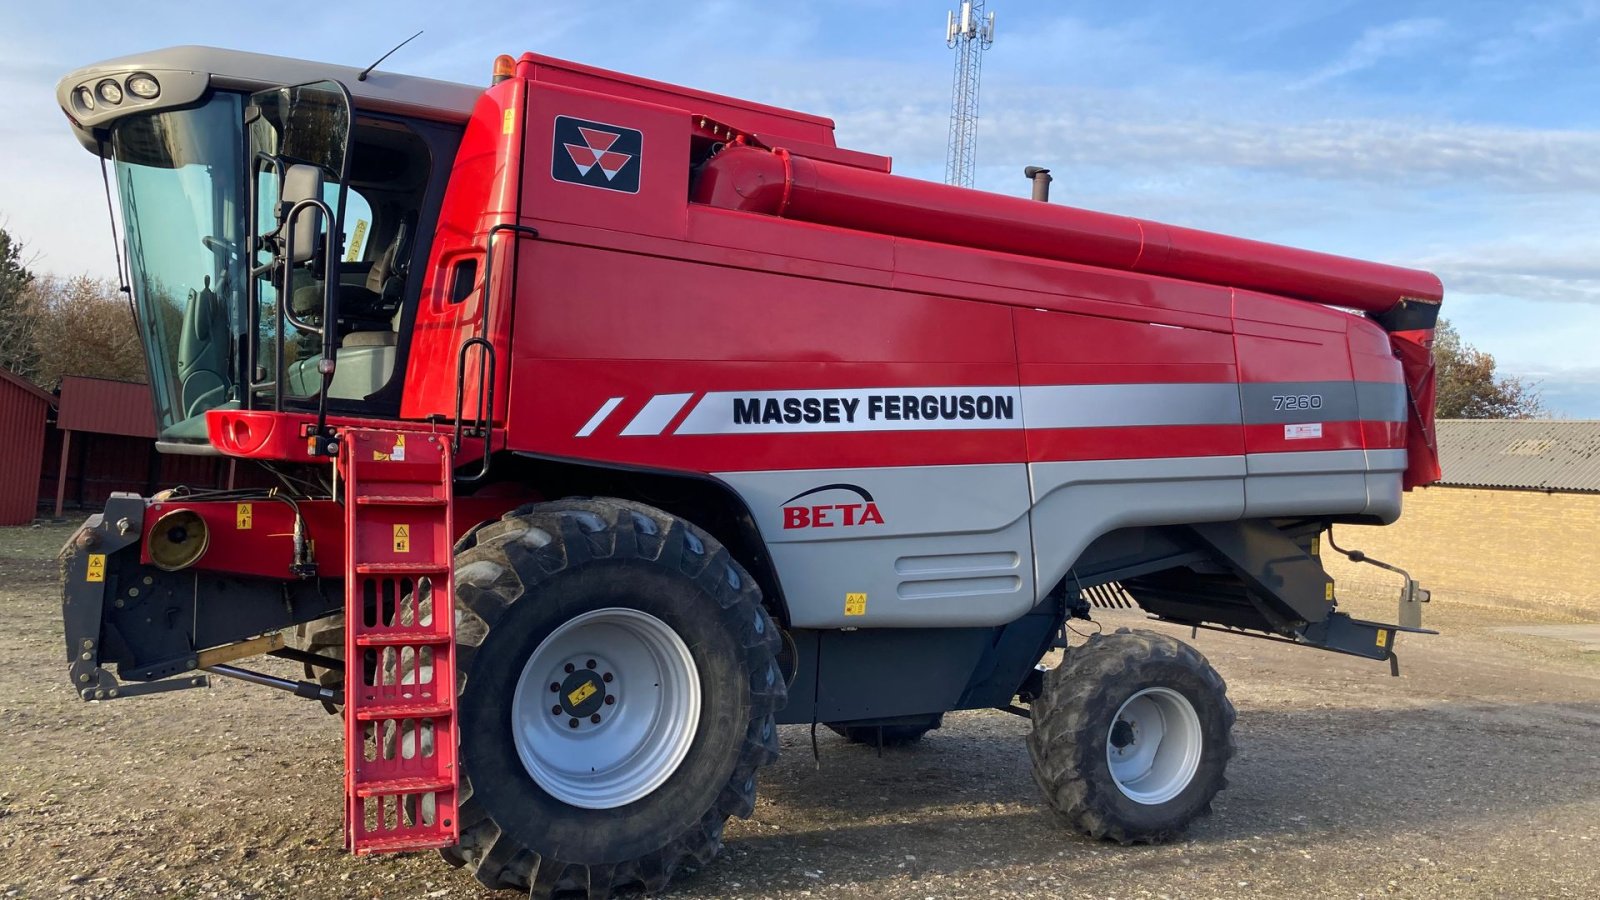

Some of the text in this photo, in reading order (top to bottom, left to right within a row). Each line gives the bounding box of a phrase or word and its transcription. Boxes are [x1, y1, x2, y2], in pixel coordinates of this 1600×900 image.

[733, 395, 1014, 425] MASSEY FERGUSON
[1272, 394, 1322, 411] 7260
[783, 502, 885, 530] BETA
